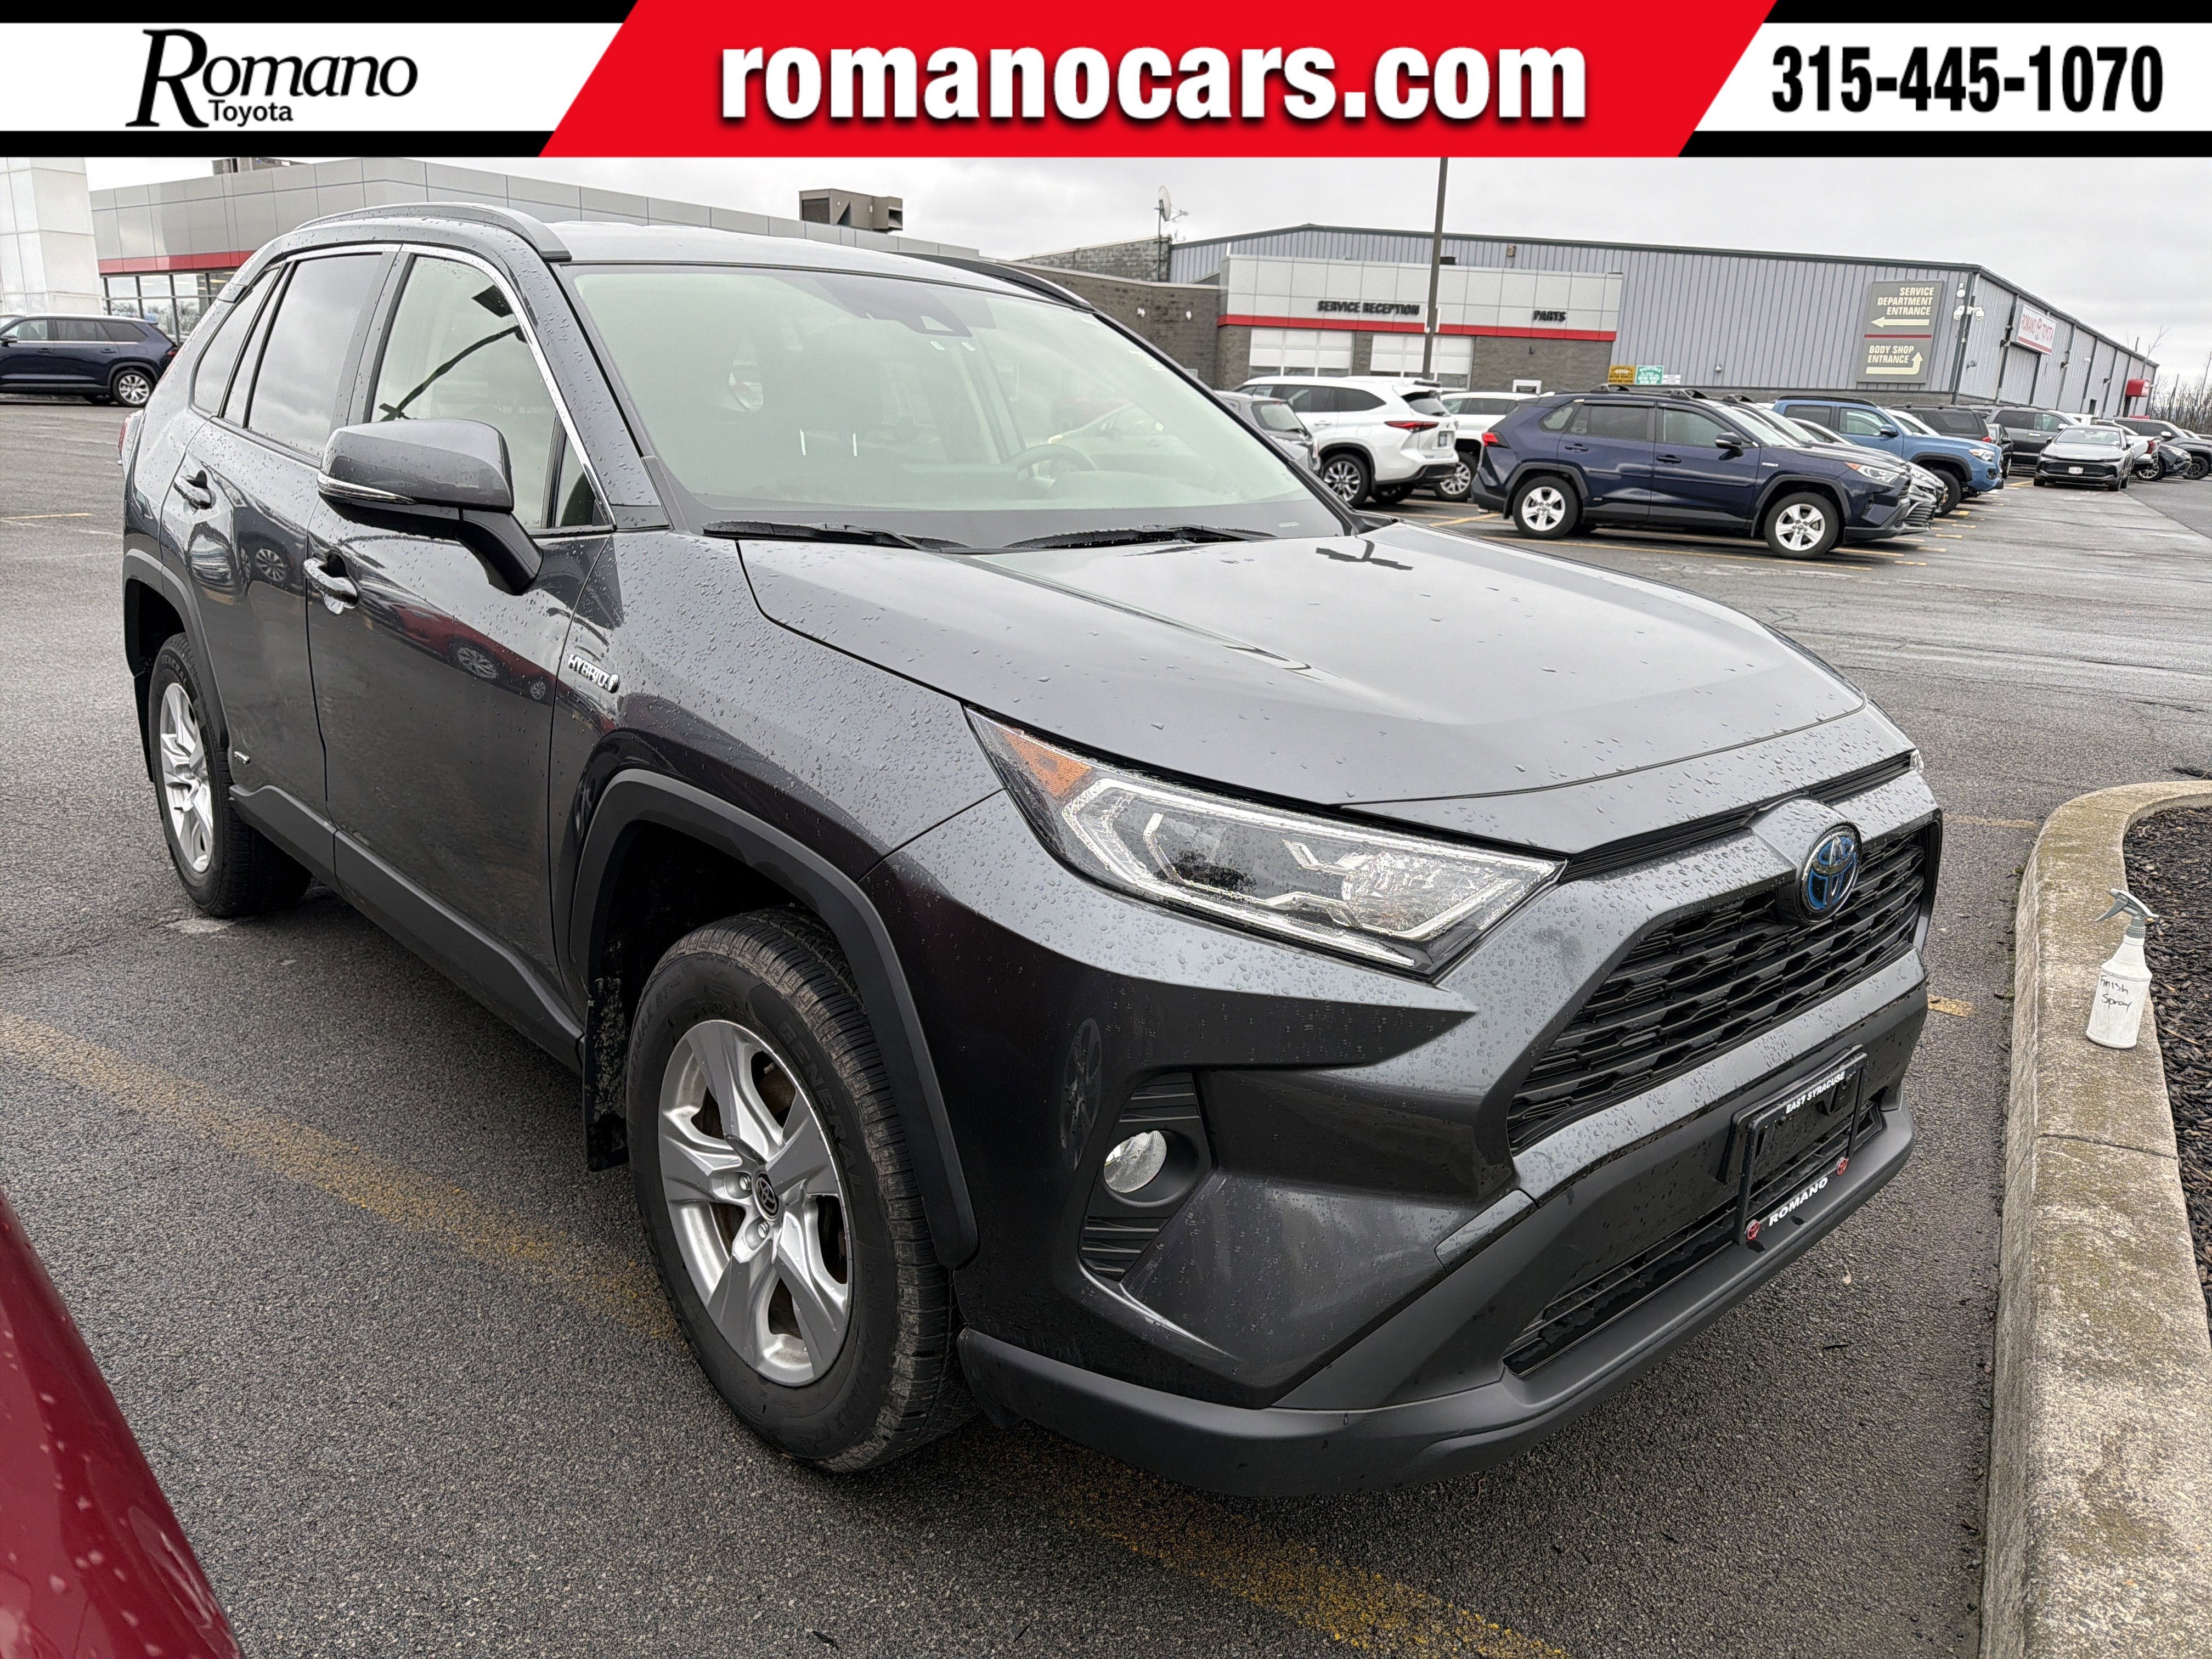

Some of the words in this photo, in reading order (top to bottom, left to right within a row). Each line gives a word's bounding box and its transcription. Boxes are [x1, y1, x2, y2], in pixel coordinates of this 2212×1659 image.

[1899, 287, 1935, 296] SERVICE
[1317, 300, 1361, 313] SERVICE
[1362, 302, 1420, 315] RECEPTION
[1877, 297, 1933, 306] DEPARTMENT
[1532, 310, 1567, 322] PARTS
[1886, 307, 1932, 315] ENTRANCE
[1869, 345, 1891, 354] BODY
[1892, 345, 1914, 354] SHOP
[1867, 355, 1909, 363] ENTRANCE
[568, 653, 610, 689] HYBRID
[2100, 975, 2129, 995] Finish
[2101, 994, 2132, 1013] Spray
[1785, 1096, 1807, 1114] EAST
[1807, 1070, 1846, 1102] SYRACUSE
[777, 1021, 864, 1199] GENERAL
[1768, 1177, 1829, 1227] ROMANO
